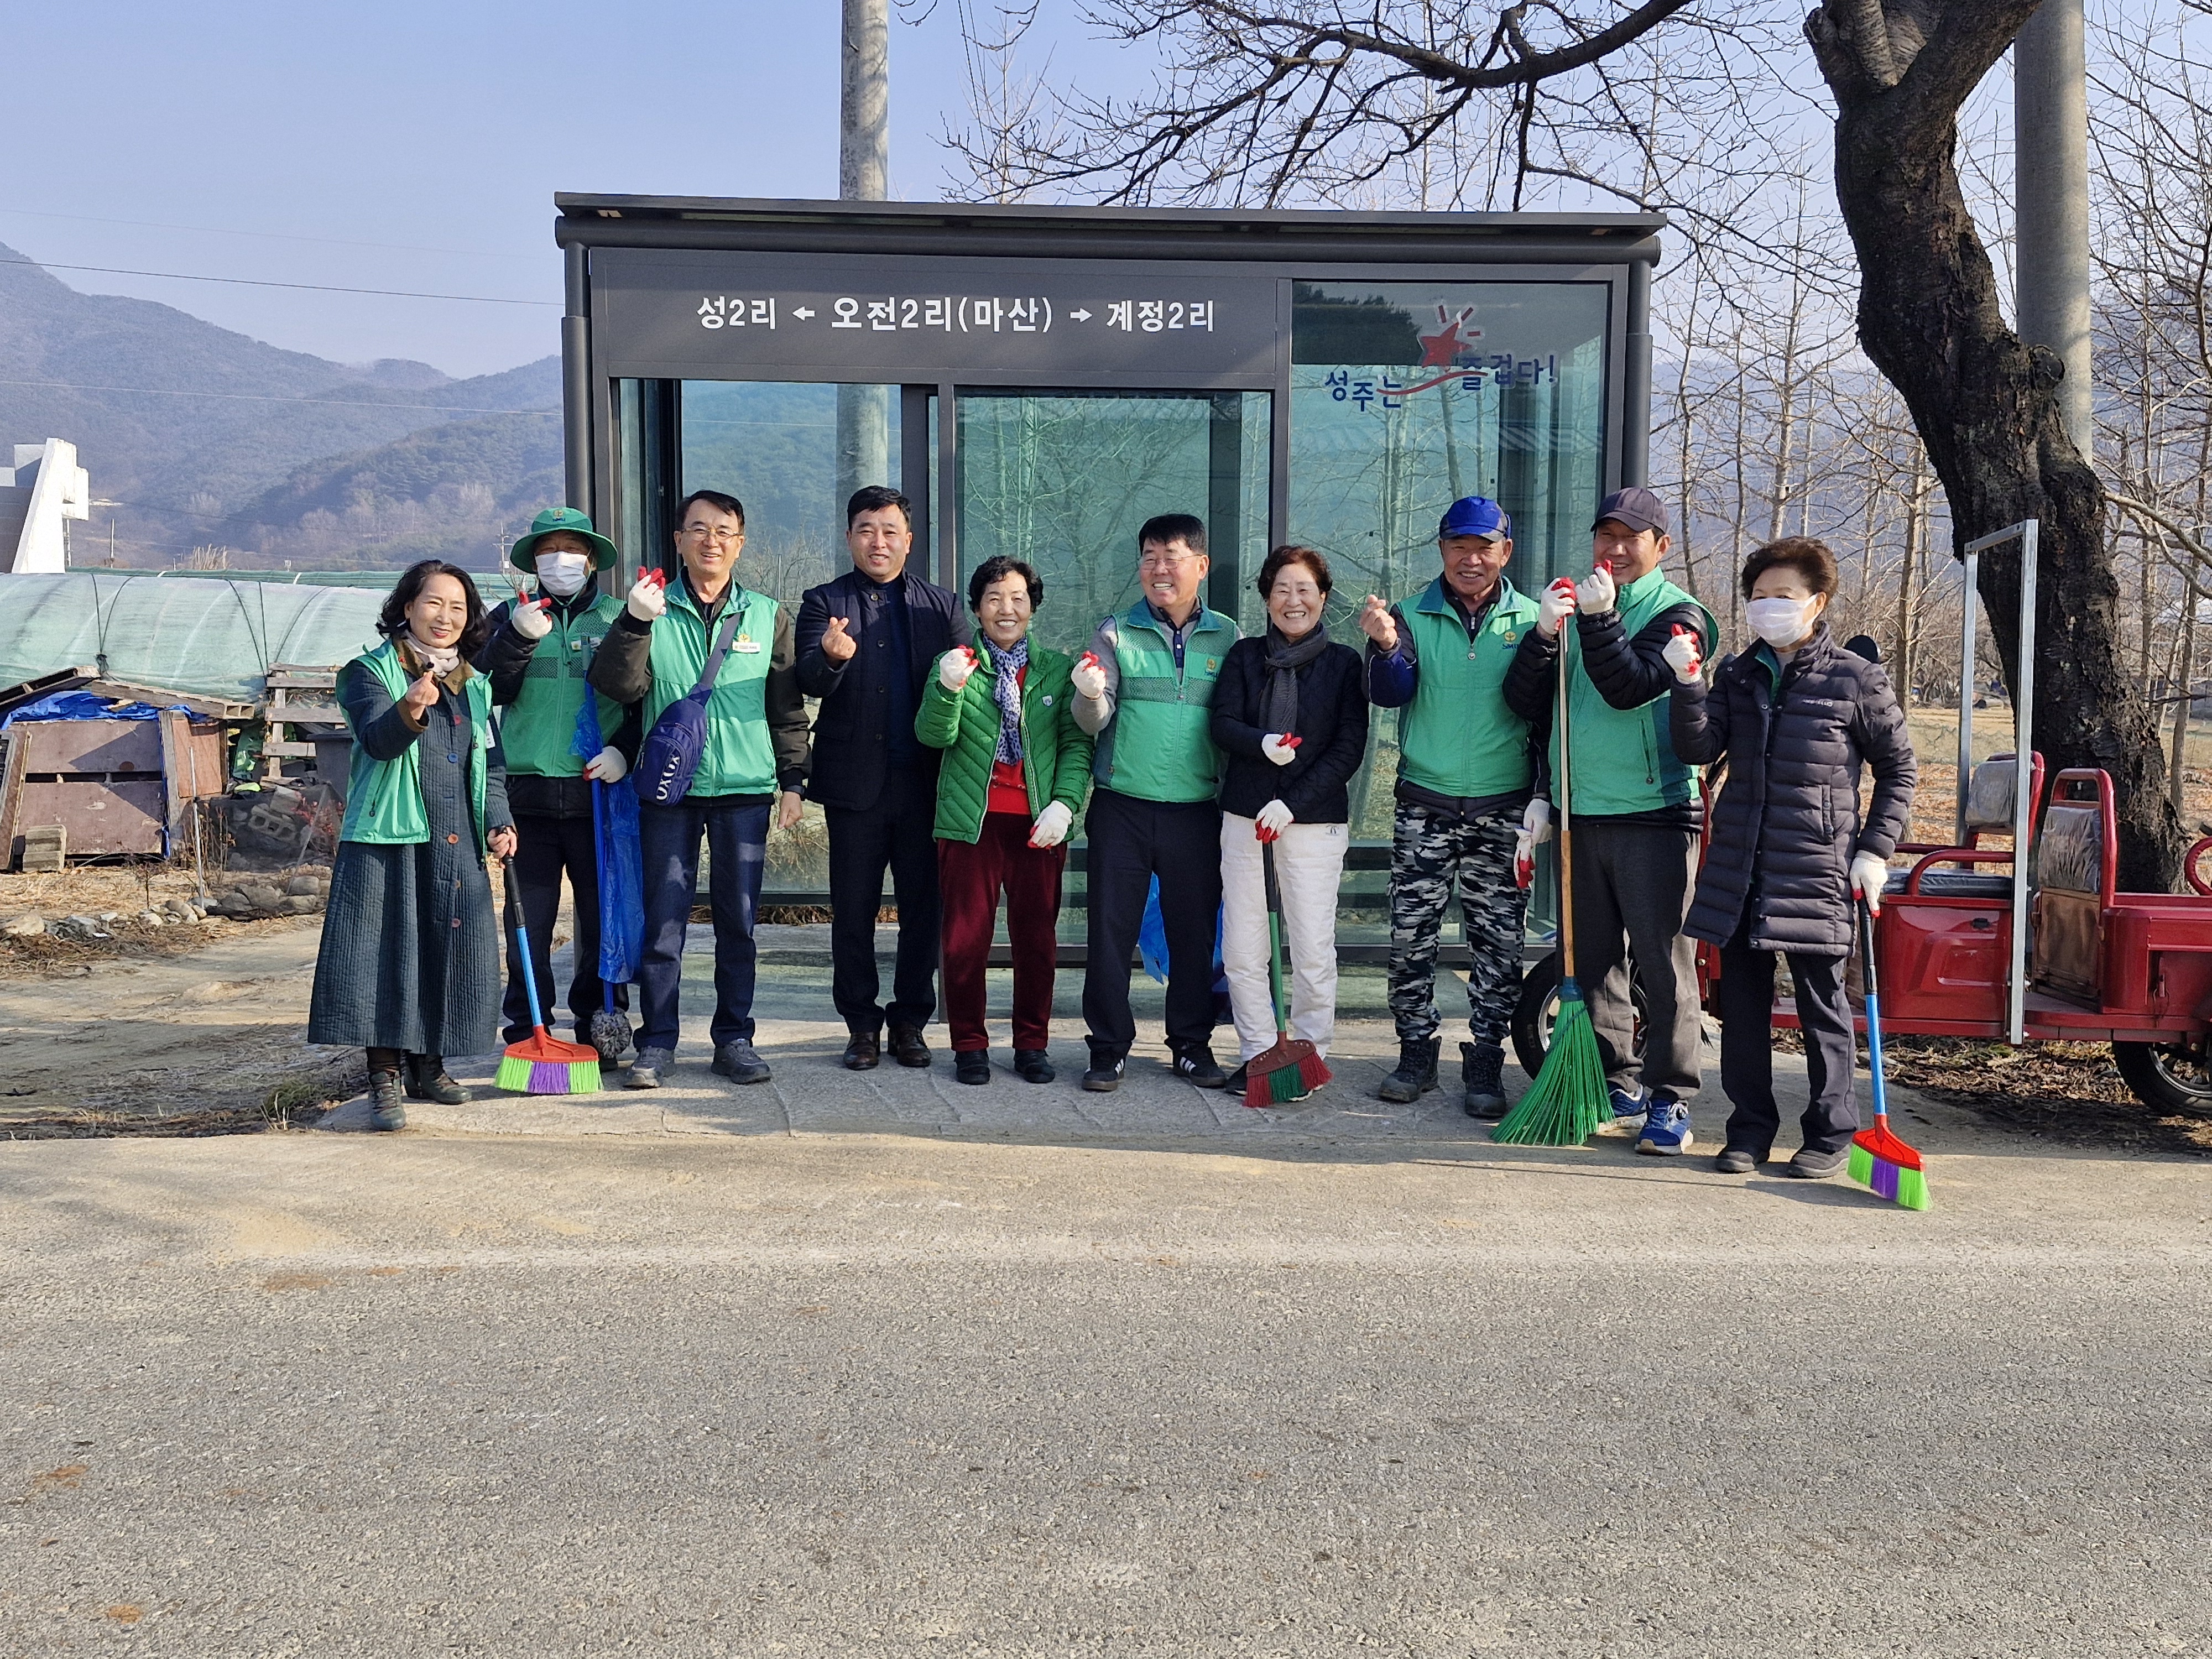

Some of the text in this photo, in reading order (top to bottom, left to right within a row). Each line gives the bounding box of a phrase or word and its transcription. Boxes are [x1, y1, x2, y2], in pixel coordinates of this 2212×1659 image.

[697, 296, 1214, 333] 성2리 오전2리(마산) 계정2리
[1324, 353, 1554, 412] 성주는 즐겁다!
